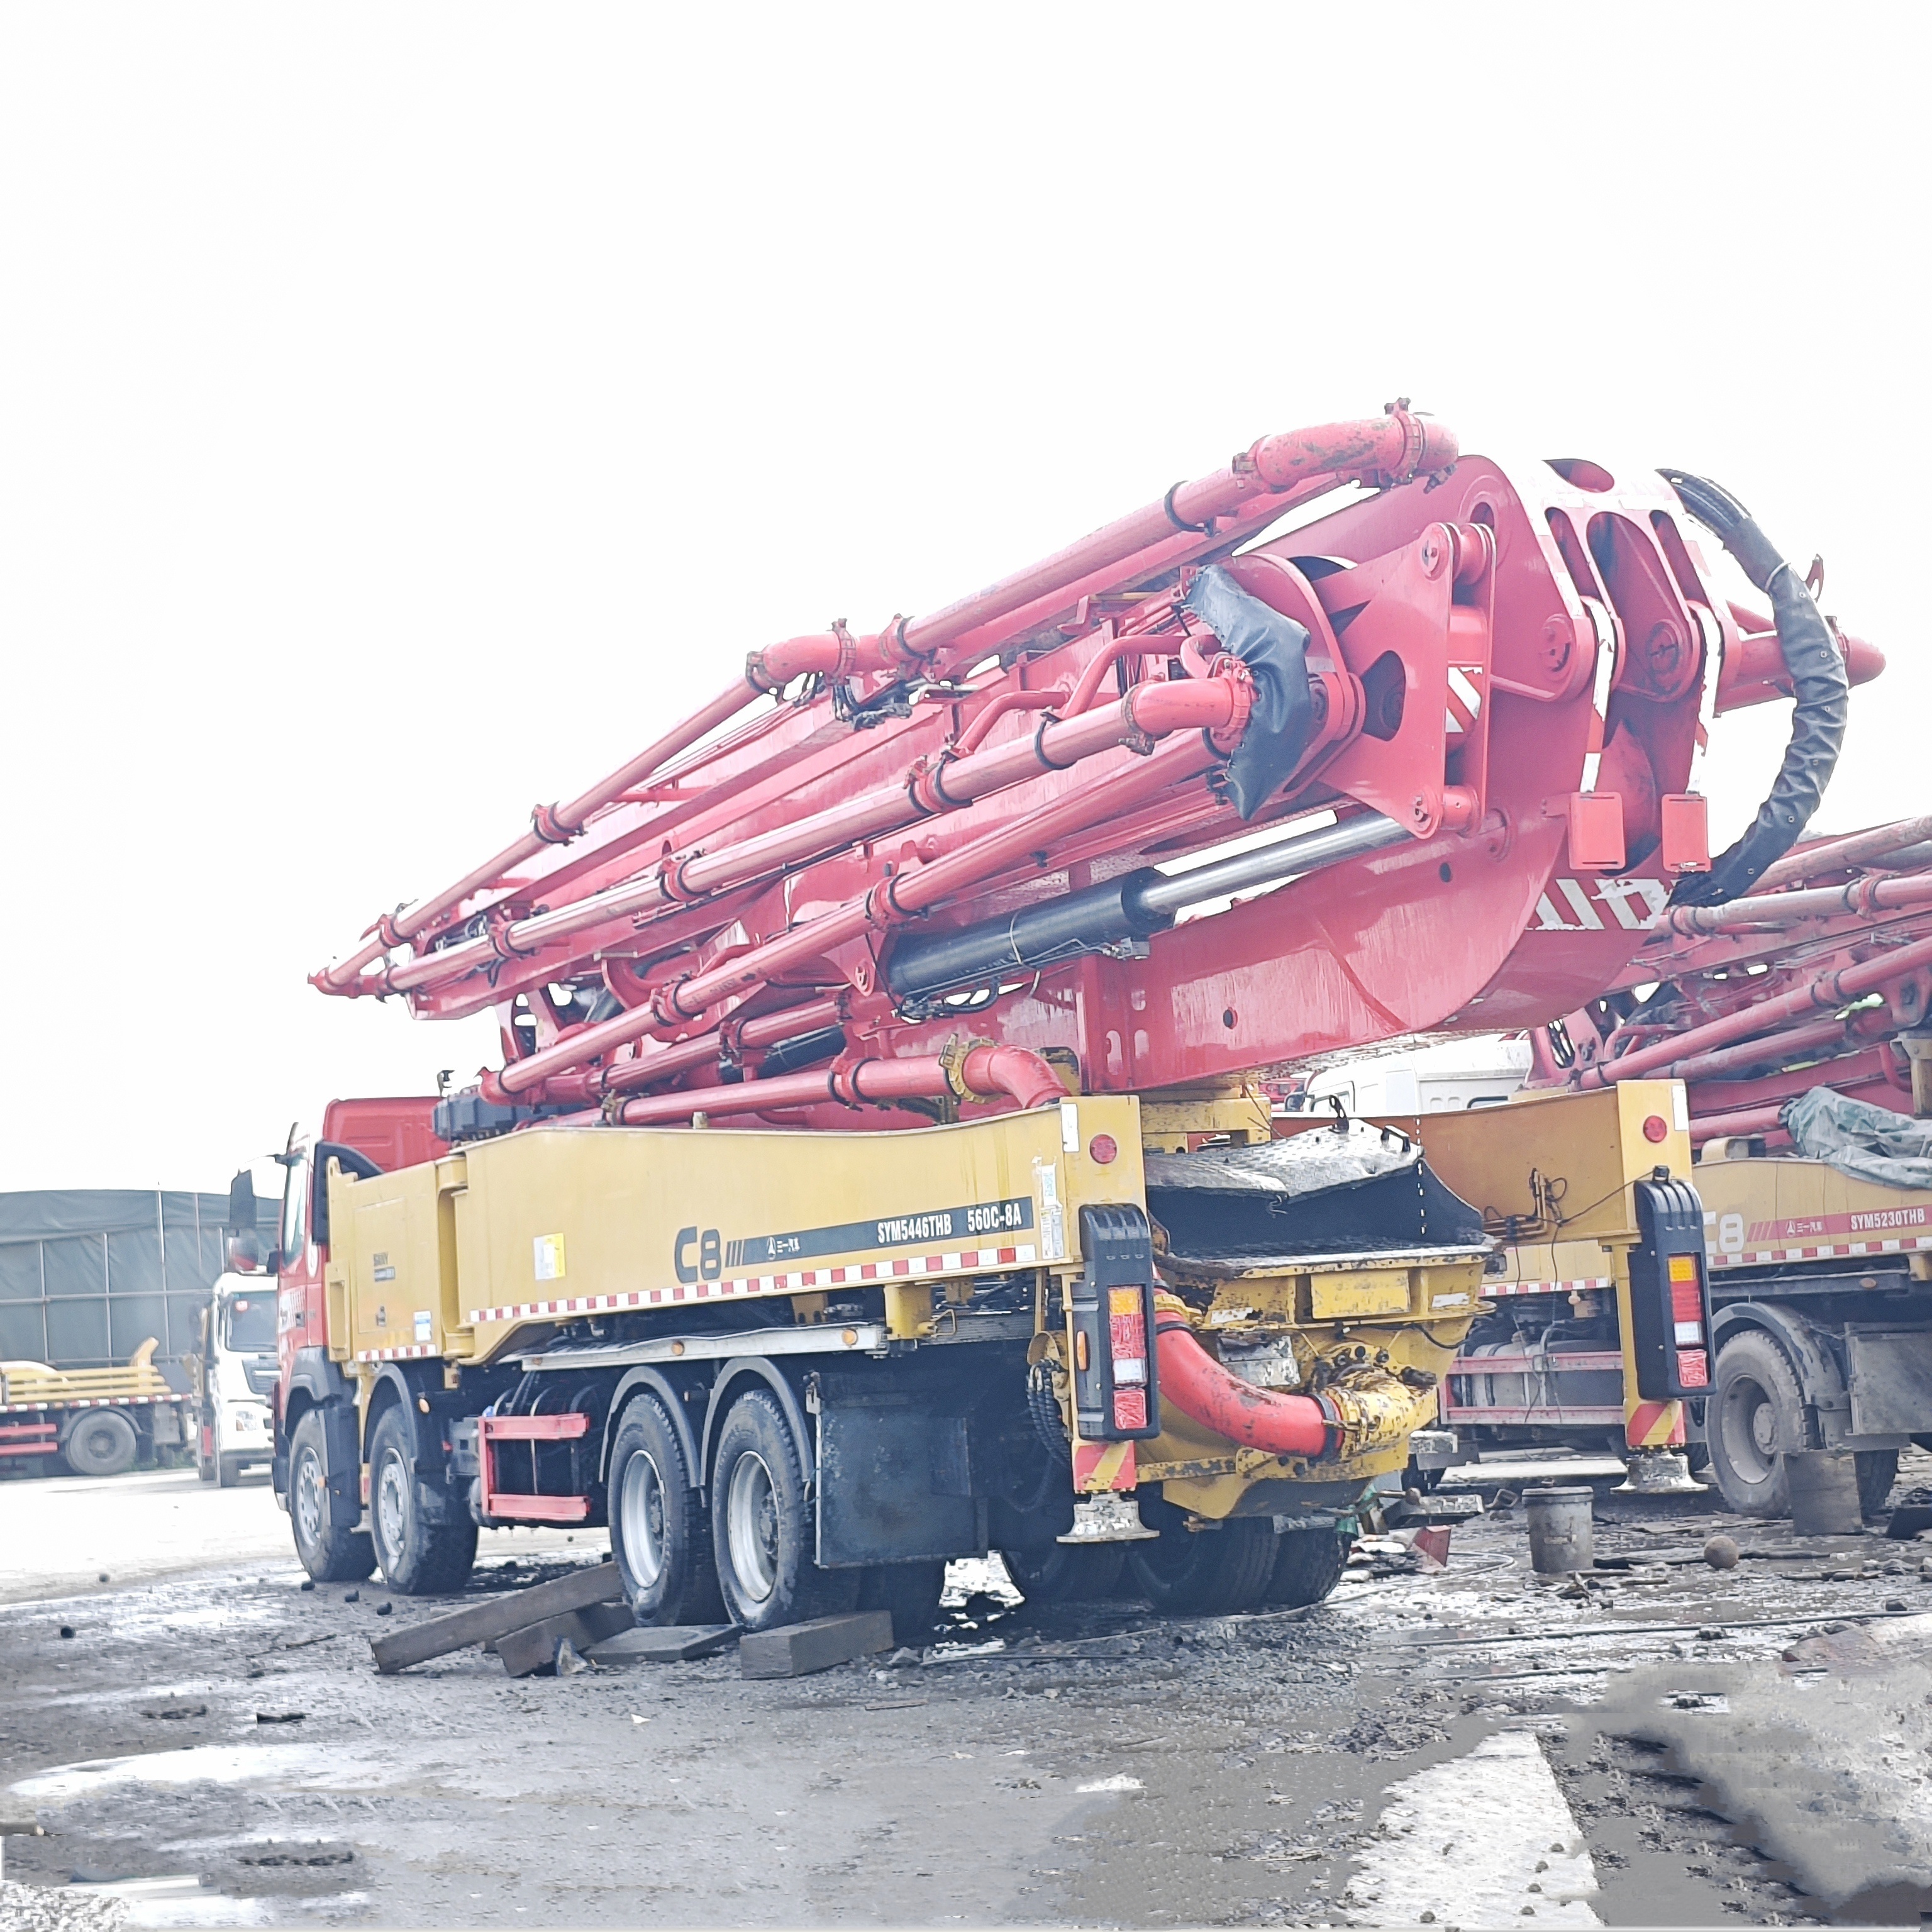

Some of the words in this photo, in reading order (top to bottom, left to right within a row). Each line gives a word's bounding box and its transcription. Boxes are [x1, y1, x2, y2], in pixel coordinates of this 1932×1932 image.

[877, 1214, 952, 1243] SYM5446THB
[967, 1202, 1022, 1231] 560C-8A
[1851, 1208, 1924, 1230] SYM5230THB
[675, 1226, 721, 1283] C8
